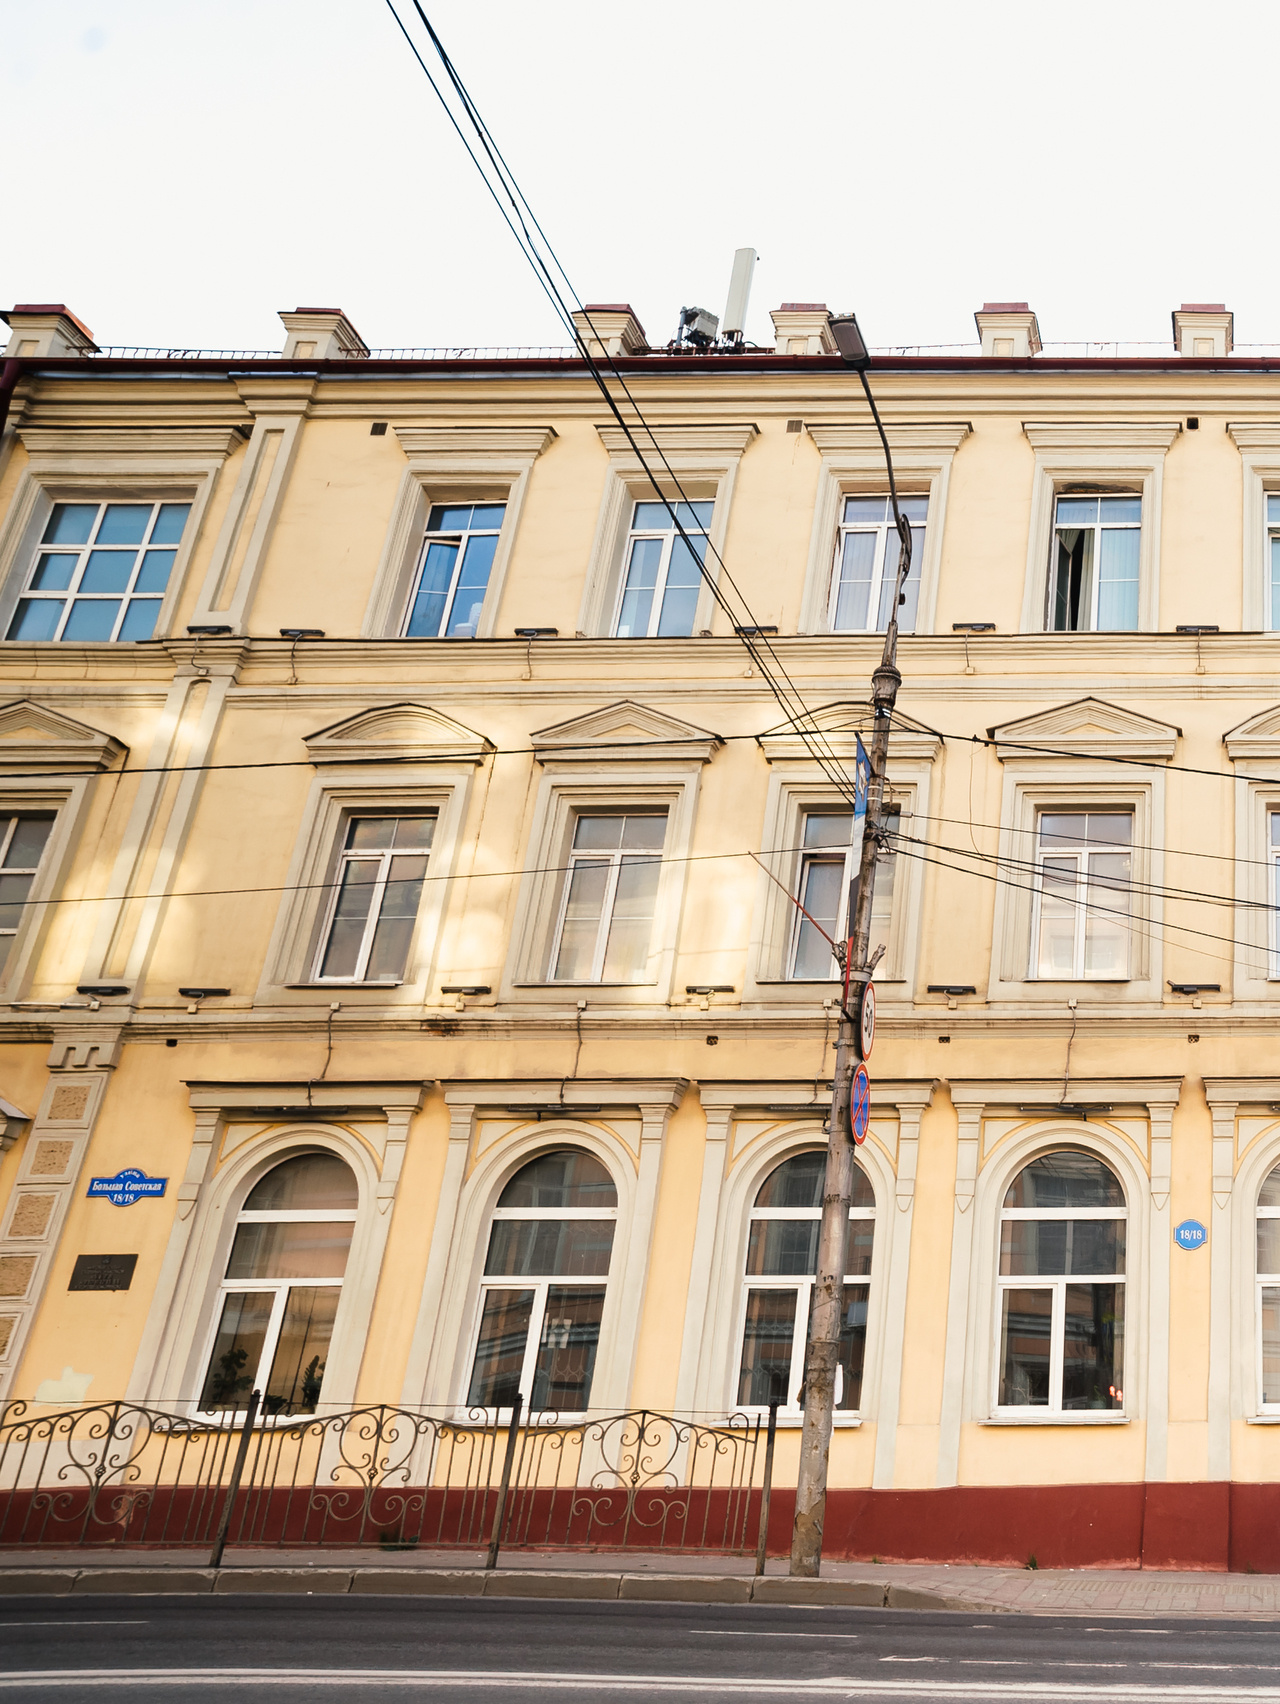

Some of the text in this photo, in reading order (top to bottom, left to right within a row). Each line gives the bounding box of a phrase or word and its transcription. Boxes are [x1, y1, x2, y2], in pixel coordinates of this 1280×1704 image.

[864, 1001, 873, 1038] 50
[92, 1181, 162, 1191] Большая Советская
[113, 1193, 134, 1203] 18/18
[1180, 1229, 1202, 1241] 18/18
